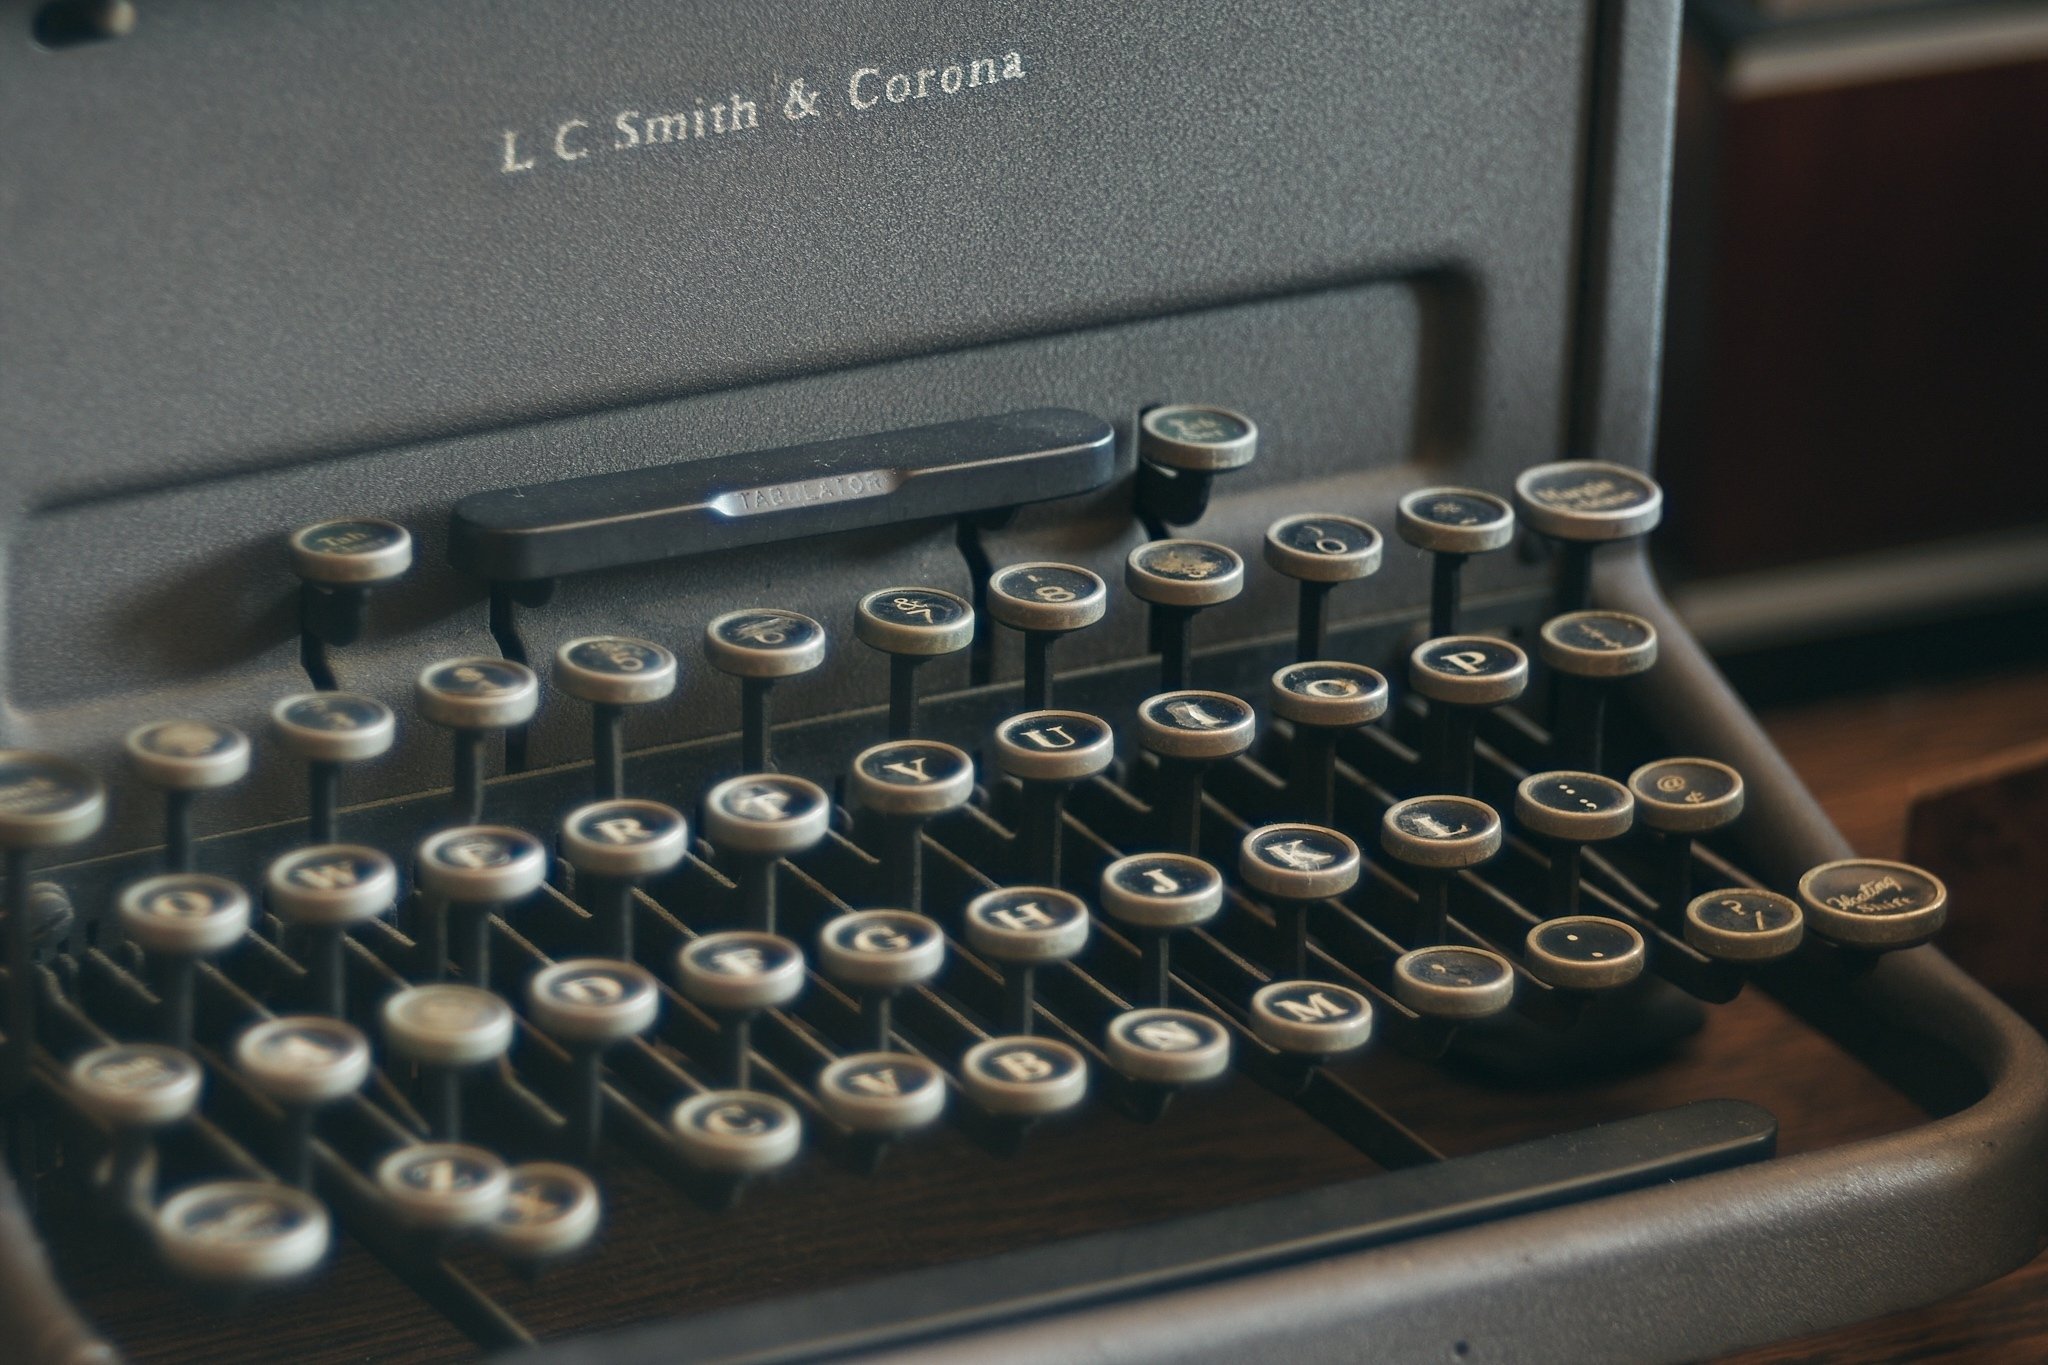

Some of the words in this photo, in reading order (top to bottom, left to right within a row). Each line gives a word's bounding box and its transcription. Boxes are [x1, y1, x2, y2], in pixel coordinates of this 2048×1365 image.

[501, 130, 535, 173] L
[554, 119, 589, 161] C
[614, 95, 758, 150] Smith
[783, 78, 820, 121] &
[850, 51, 1026, 110] Corona
[894, 598, 928, 612] &
[1036, 586, 1076, 602] 8
[906, 608, 934, 624] 7
[1441, 651, 1487, 674] P
[1306, 680, 1358, 697] O
[1020, 726, 1076, 748] U
[883, 758, 935, 782] Y
[1657, 776, 1685, 792] @
[594, 818, 654, 843] R
[1412, 816, 1468, 837] L
[1265, 839, 1332, 868] K
[1142, 868, 1180, 893] J
[990, 902, 1058, 931] H
[1721, 899, 1746, 916] ?
[854, 926, 911, 951] G
[1273, 992, 1349, 1022] M
[993, 1050, 1053, 1081] B
[850, 1068, 900, 1096] V
[705, 1106, 765, 1136] C
